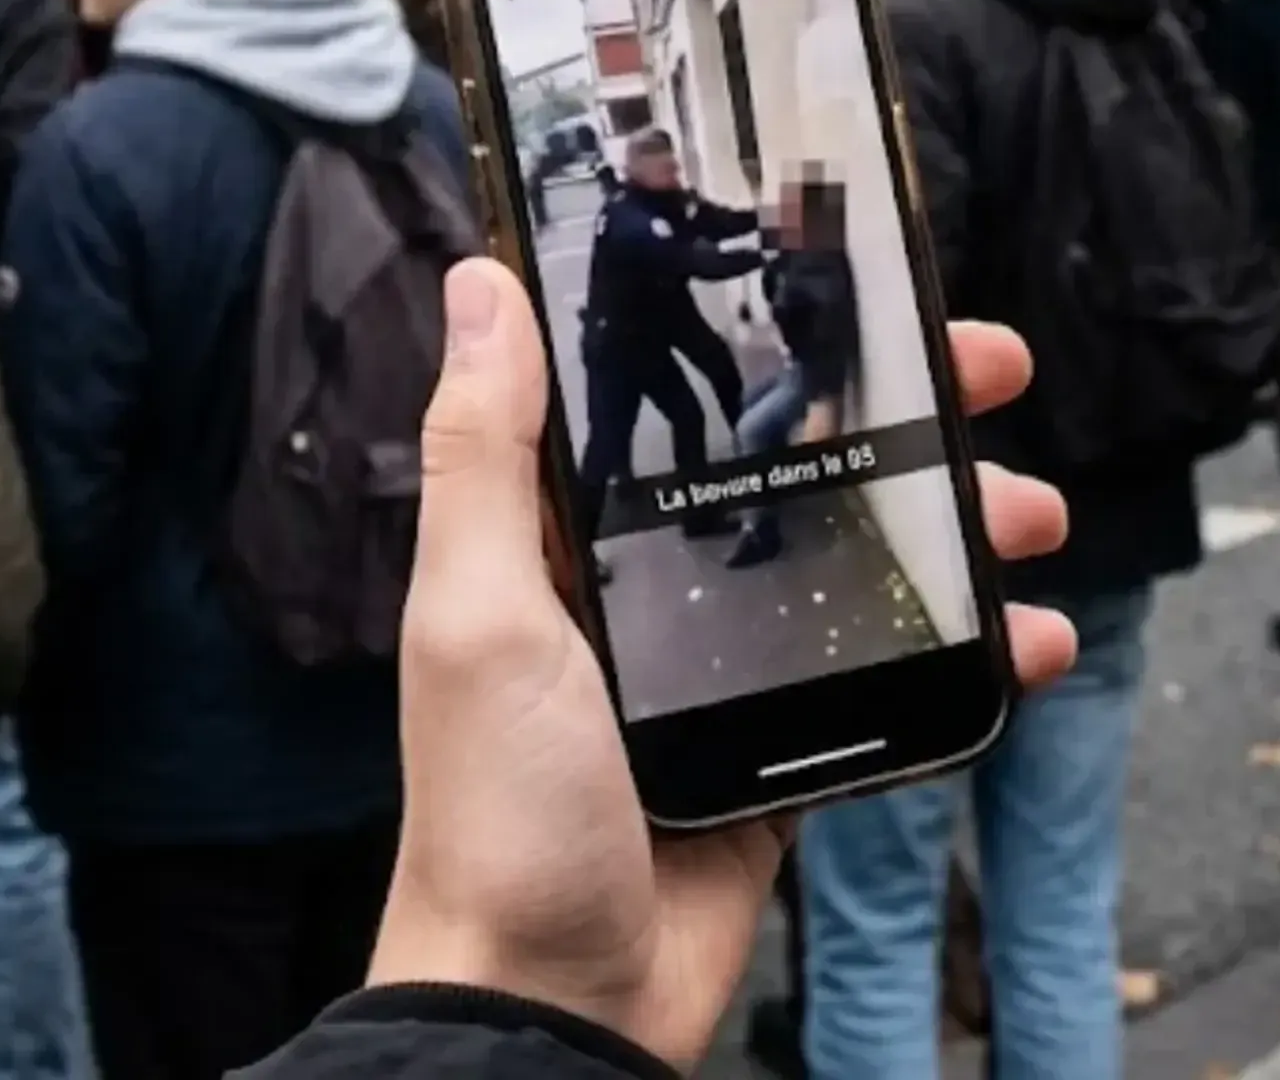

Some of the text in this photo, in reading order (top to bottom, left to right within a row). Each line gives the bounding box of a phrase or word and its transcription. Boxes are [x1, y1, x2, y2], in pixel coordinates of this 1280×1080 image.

[655, 488, 687, 512] La
[767, 461, 819, 487] dans
[821, 452, 842, 476] le
